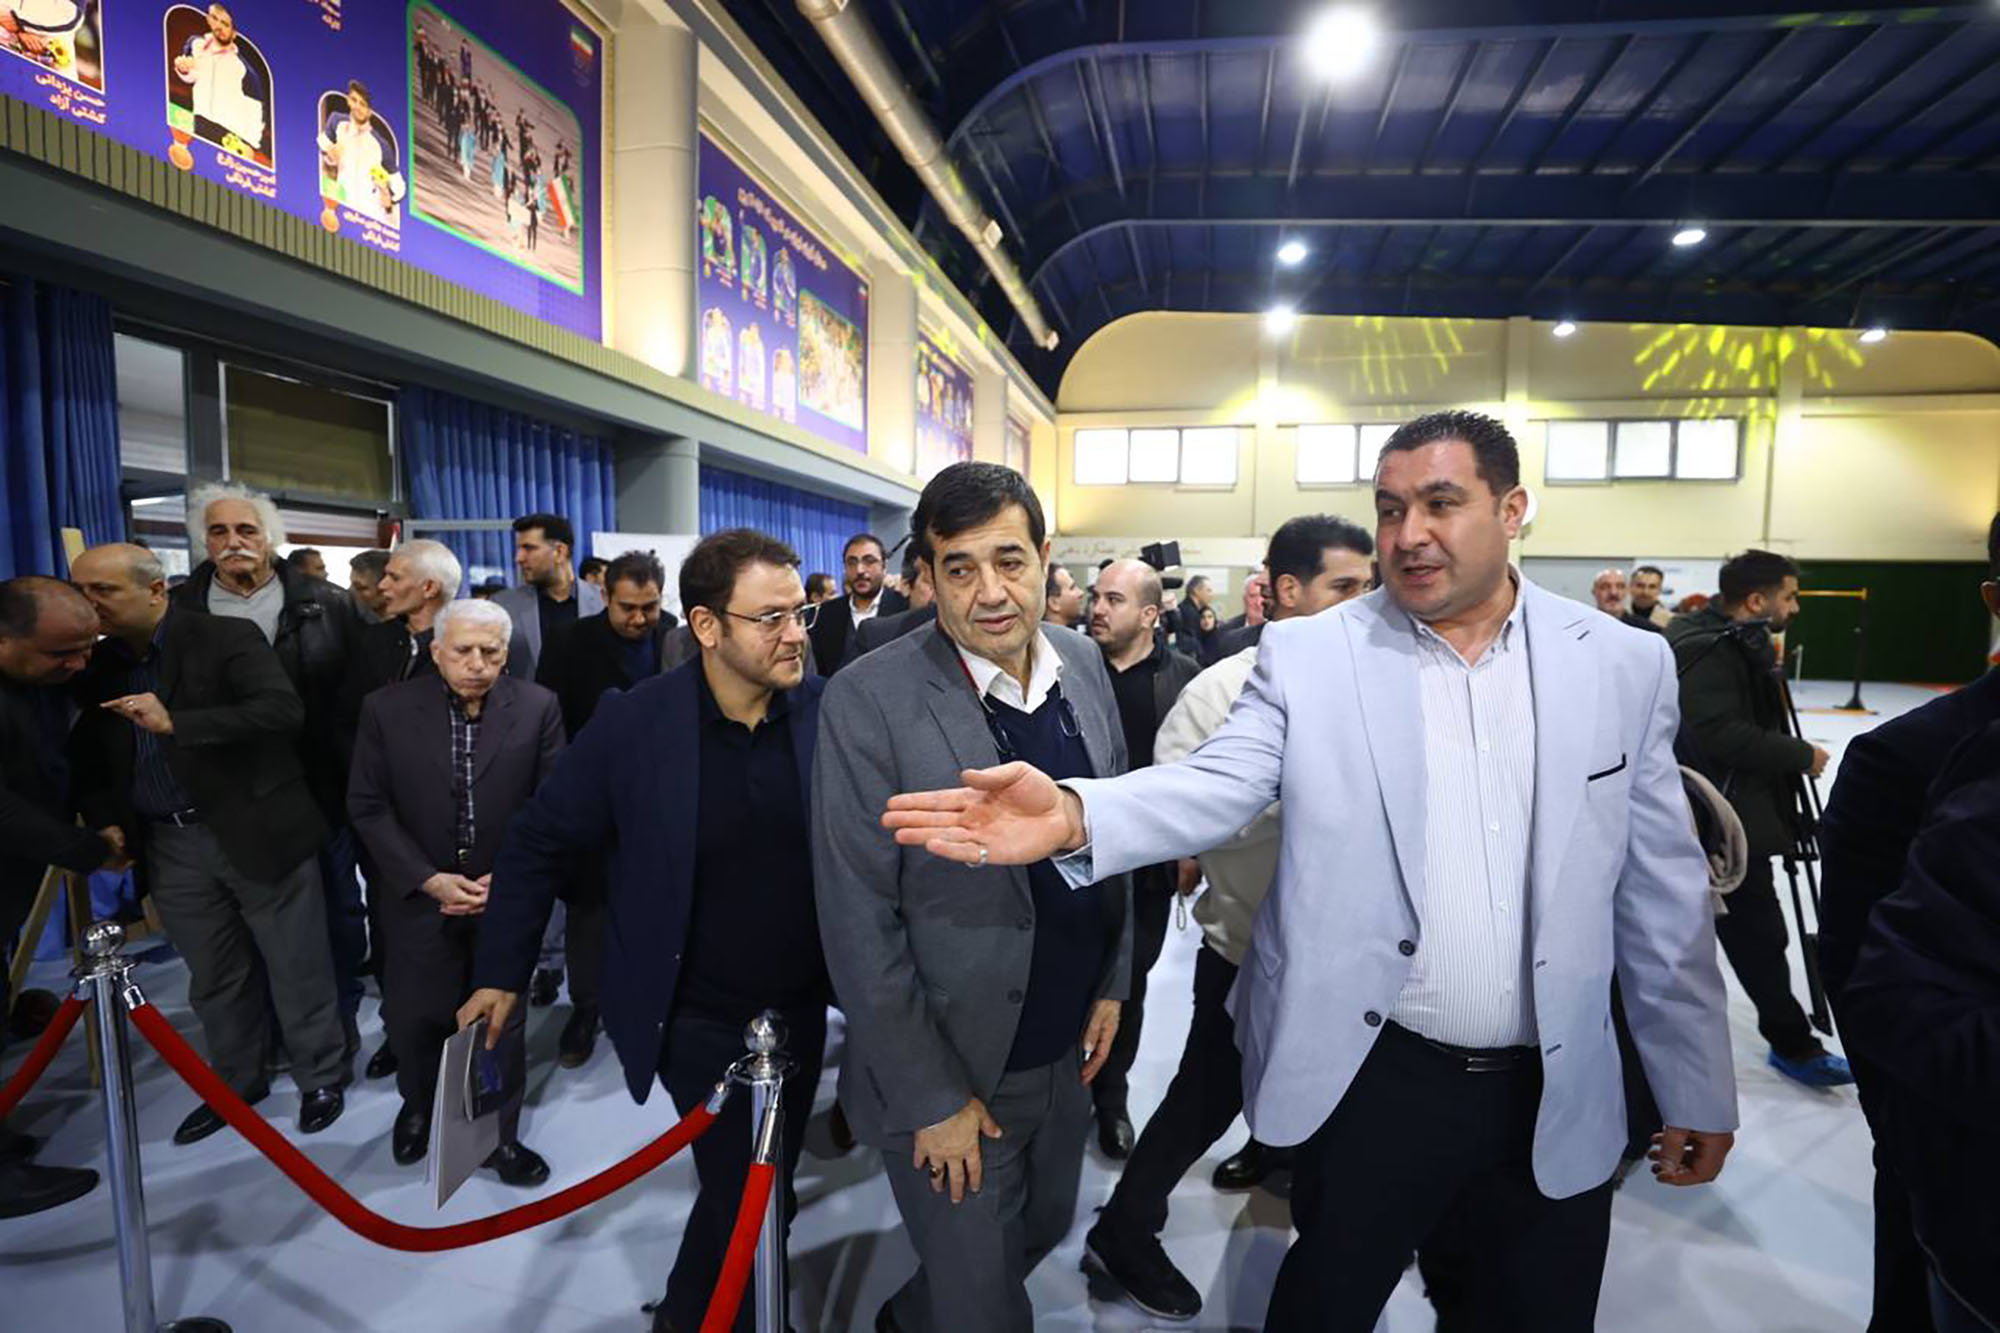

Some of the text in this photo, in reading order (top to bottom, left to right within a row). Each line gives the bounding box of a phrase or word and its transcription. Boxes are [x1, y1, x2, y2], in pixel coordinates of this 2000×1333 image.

[35, 73, 106, 107] حسن یزدانی
[49, 93, 106, 124] کشتی آزاد
